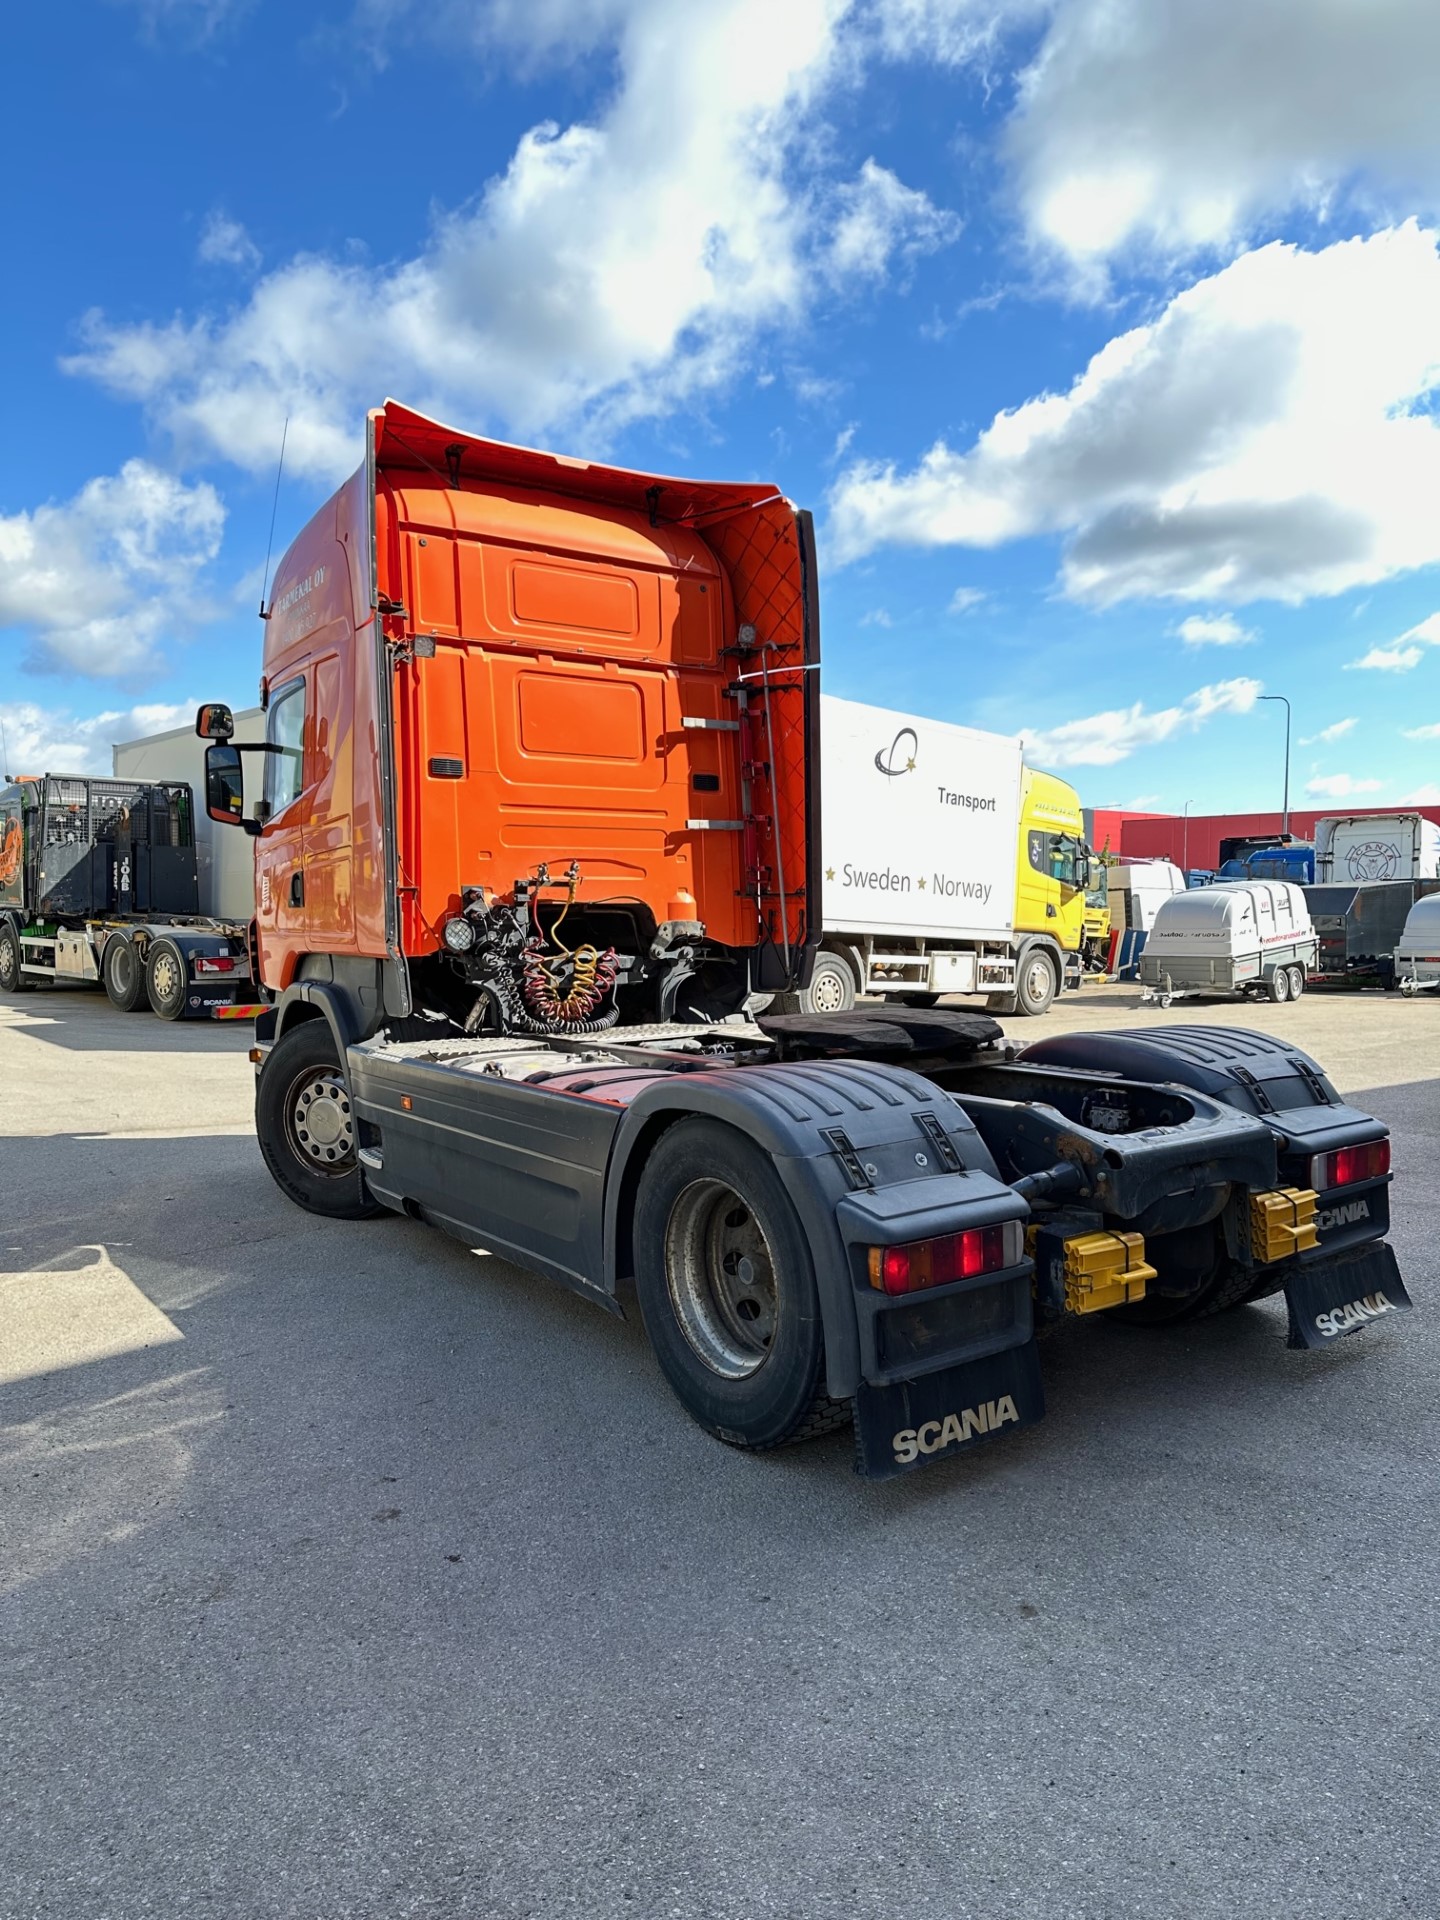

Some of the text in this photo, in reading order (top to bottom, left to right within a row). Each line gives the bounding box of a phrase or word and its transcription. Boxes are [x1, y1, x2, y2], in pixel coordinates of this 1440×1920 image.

[314, 565, 326, 588] OY
[937, 786, 996, 812] Transport
[1351, 843, 1394, 863] SCANIA
[120, 856, 131, 891] JOAB
[842, 863, 993, 906] Sweden Norway
[203, 998, 233, 1006] SCANIA
[1315, 1291, 1397, 1337] SCANIA
[892, 1394, 1020, 1464] SCANIA
